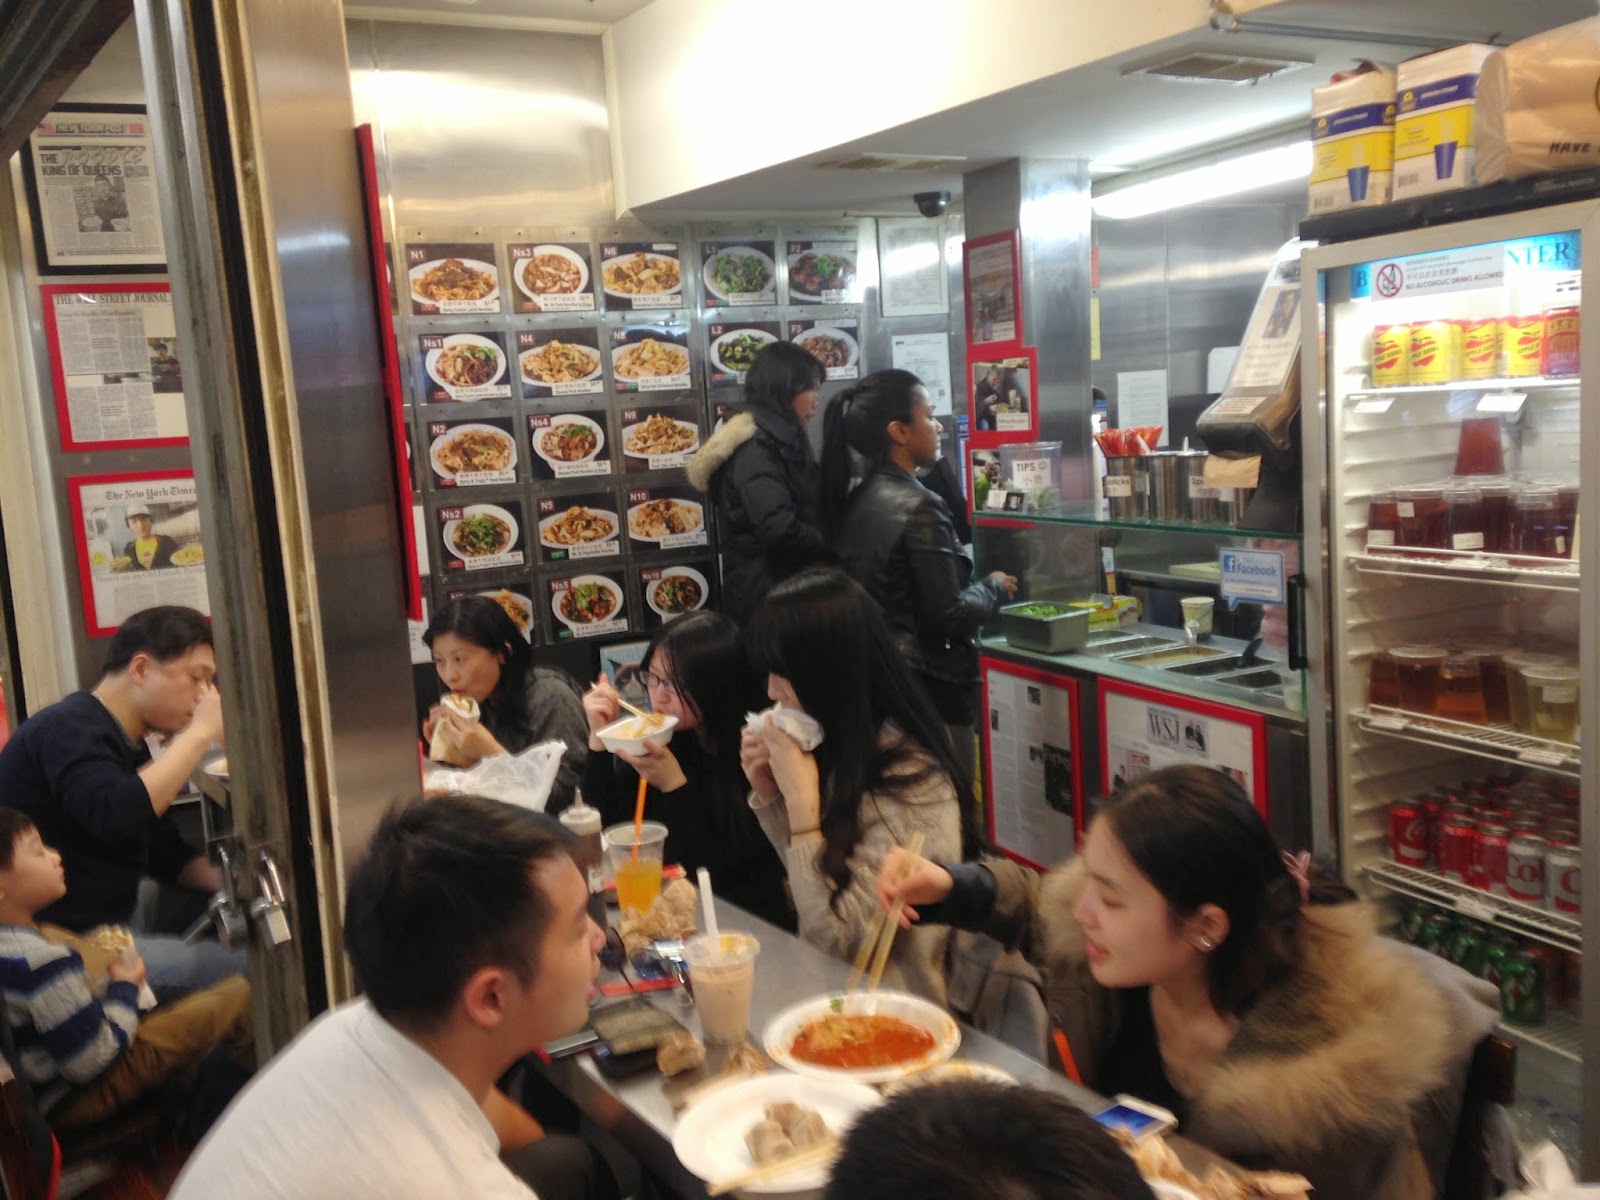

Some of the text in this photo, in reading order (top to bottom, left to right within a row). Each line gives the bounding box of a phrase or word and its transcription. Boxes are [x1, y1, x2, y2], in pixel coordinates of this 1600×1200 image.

[1549, 142, 1592, 153] HAVE
[41, 153, 58, 164] THE
[42, 165, 67, 176] KING
[67, 165, 80, 176] OF
[82, 165, 122, 176] QUEENS
[411, 250, 424, 259] N1
[513, 249, 531, 257] Ns3
[604, 247, 617, 255] N6
[1416, 278, 1451, 289] ALCOHOLIC
[1451, 275, 1473, 284] DRINKS
[1474, 270, 1504, 281] ALLOWED
[56, 295, 72, 305] THE
[99, 293, 132, 304] STREET
[711, 326, 722, 334] L2
[520, 335, 533, 343] N4
[614, 332, 625, 340] N8
[424, 338, 442, 347] Ns1
[624, 411, 636, 419] N9
[530, 418, 548, 427] Ns4
[432, 425, 446, 434] N2
[1016, 462, 1036, 472] TIPS
[105, 486, 197, 501] The New York Times
[630, 492, 646, 501] N10
[541, 501, 554, 510] N5
[442, 510, 460, 519] Ns2
[1237, 563, 1277, 576] Facebook
[642, 572, 660, 580] Ns10
[552, 581, 569, 590] Ns5
[1149, 712, 1180, 745] WSJ
